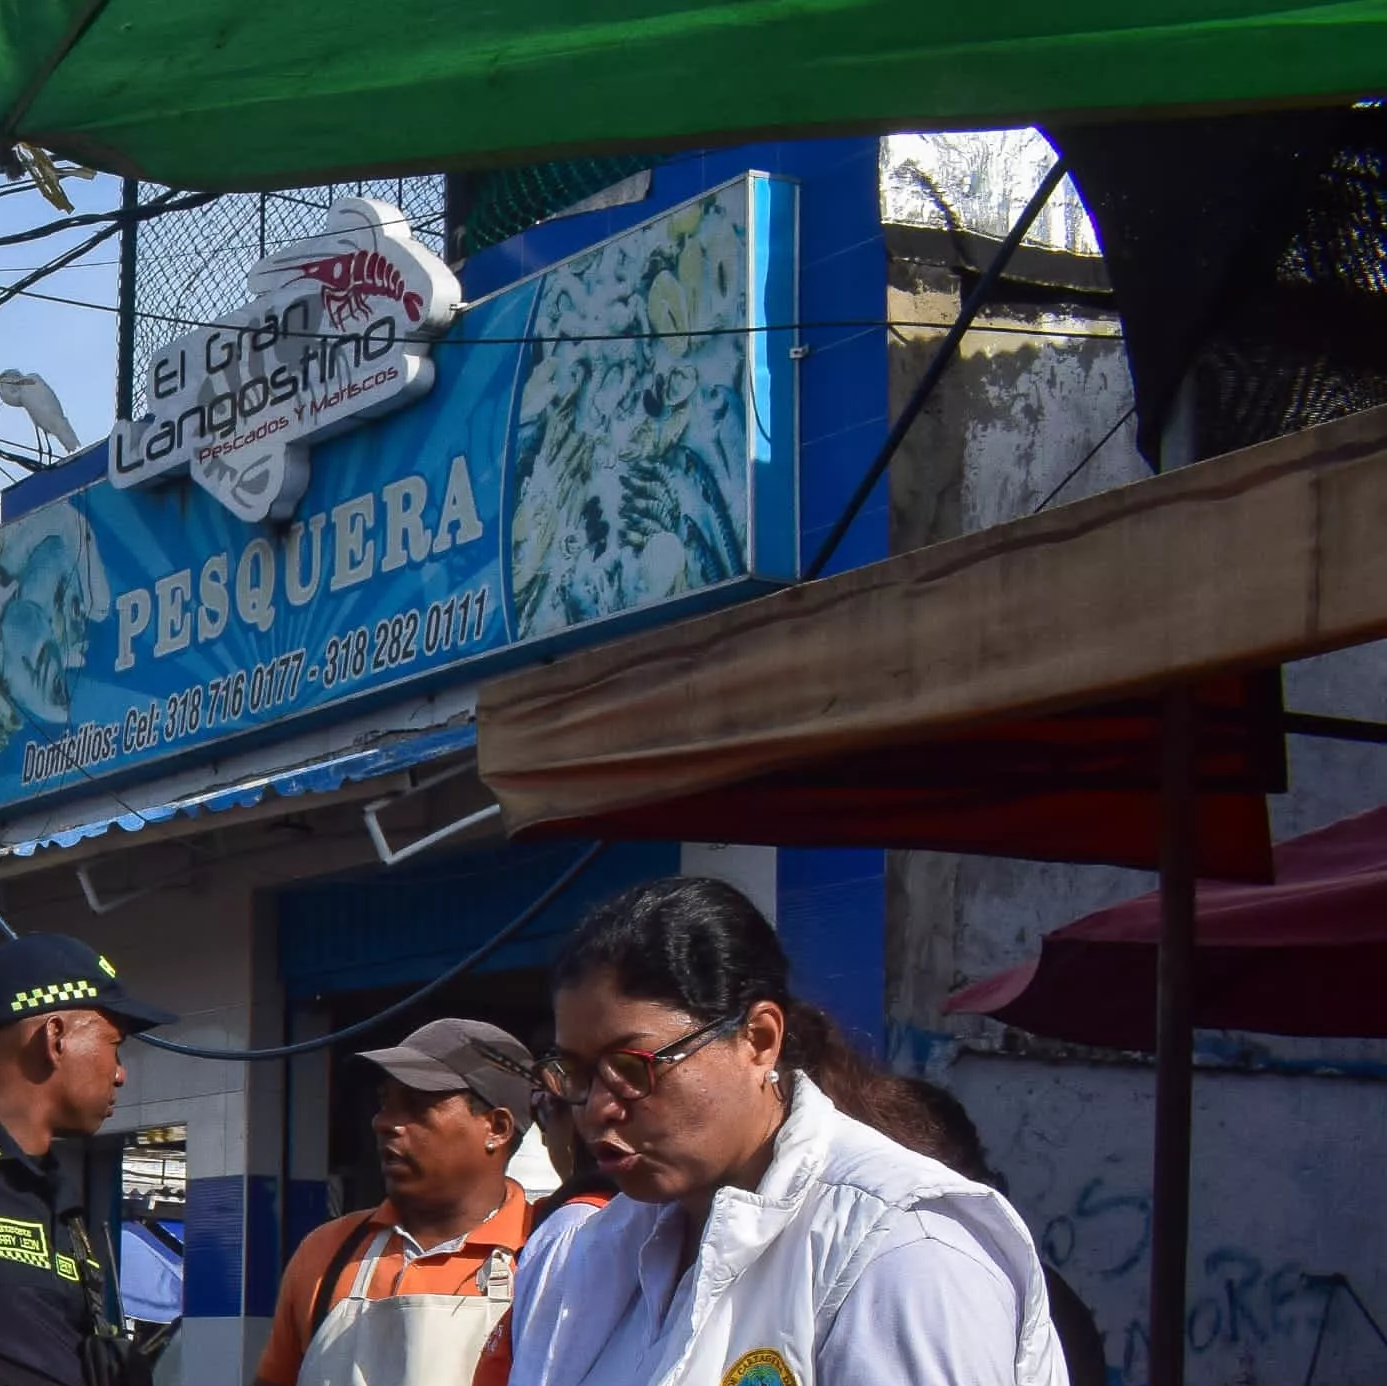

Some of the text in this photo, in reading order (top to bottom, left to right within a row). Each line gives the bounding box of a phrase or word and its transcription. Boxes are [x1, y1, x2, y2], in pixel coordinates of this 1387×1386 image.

[115, 316, 396, 474] Langostino
[153, 300, 309, 399] El Gran
[198, 416, 289, 464] Pescados
[309, 366, 399, 416] Mariscos
[114, 455, 484, 672] PESQUERA
[21, 719, 120, 786] Domicilios:
[123, 700, 161, 753] Cel:
[163, 684, 203, 742] 318
[206, 669, 246, 728] 716
[249, 648, 307, 713] 0177
[323, 626, 368, 688] 318
[372, 607, 420, 672] 282
[424, 585, 490, 656] 0111
